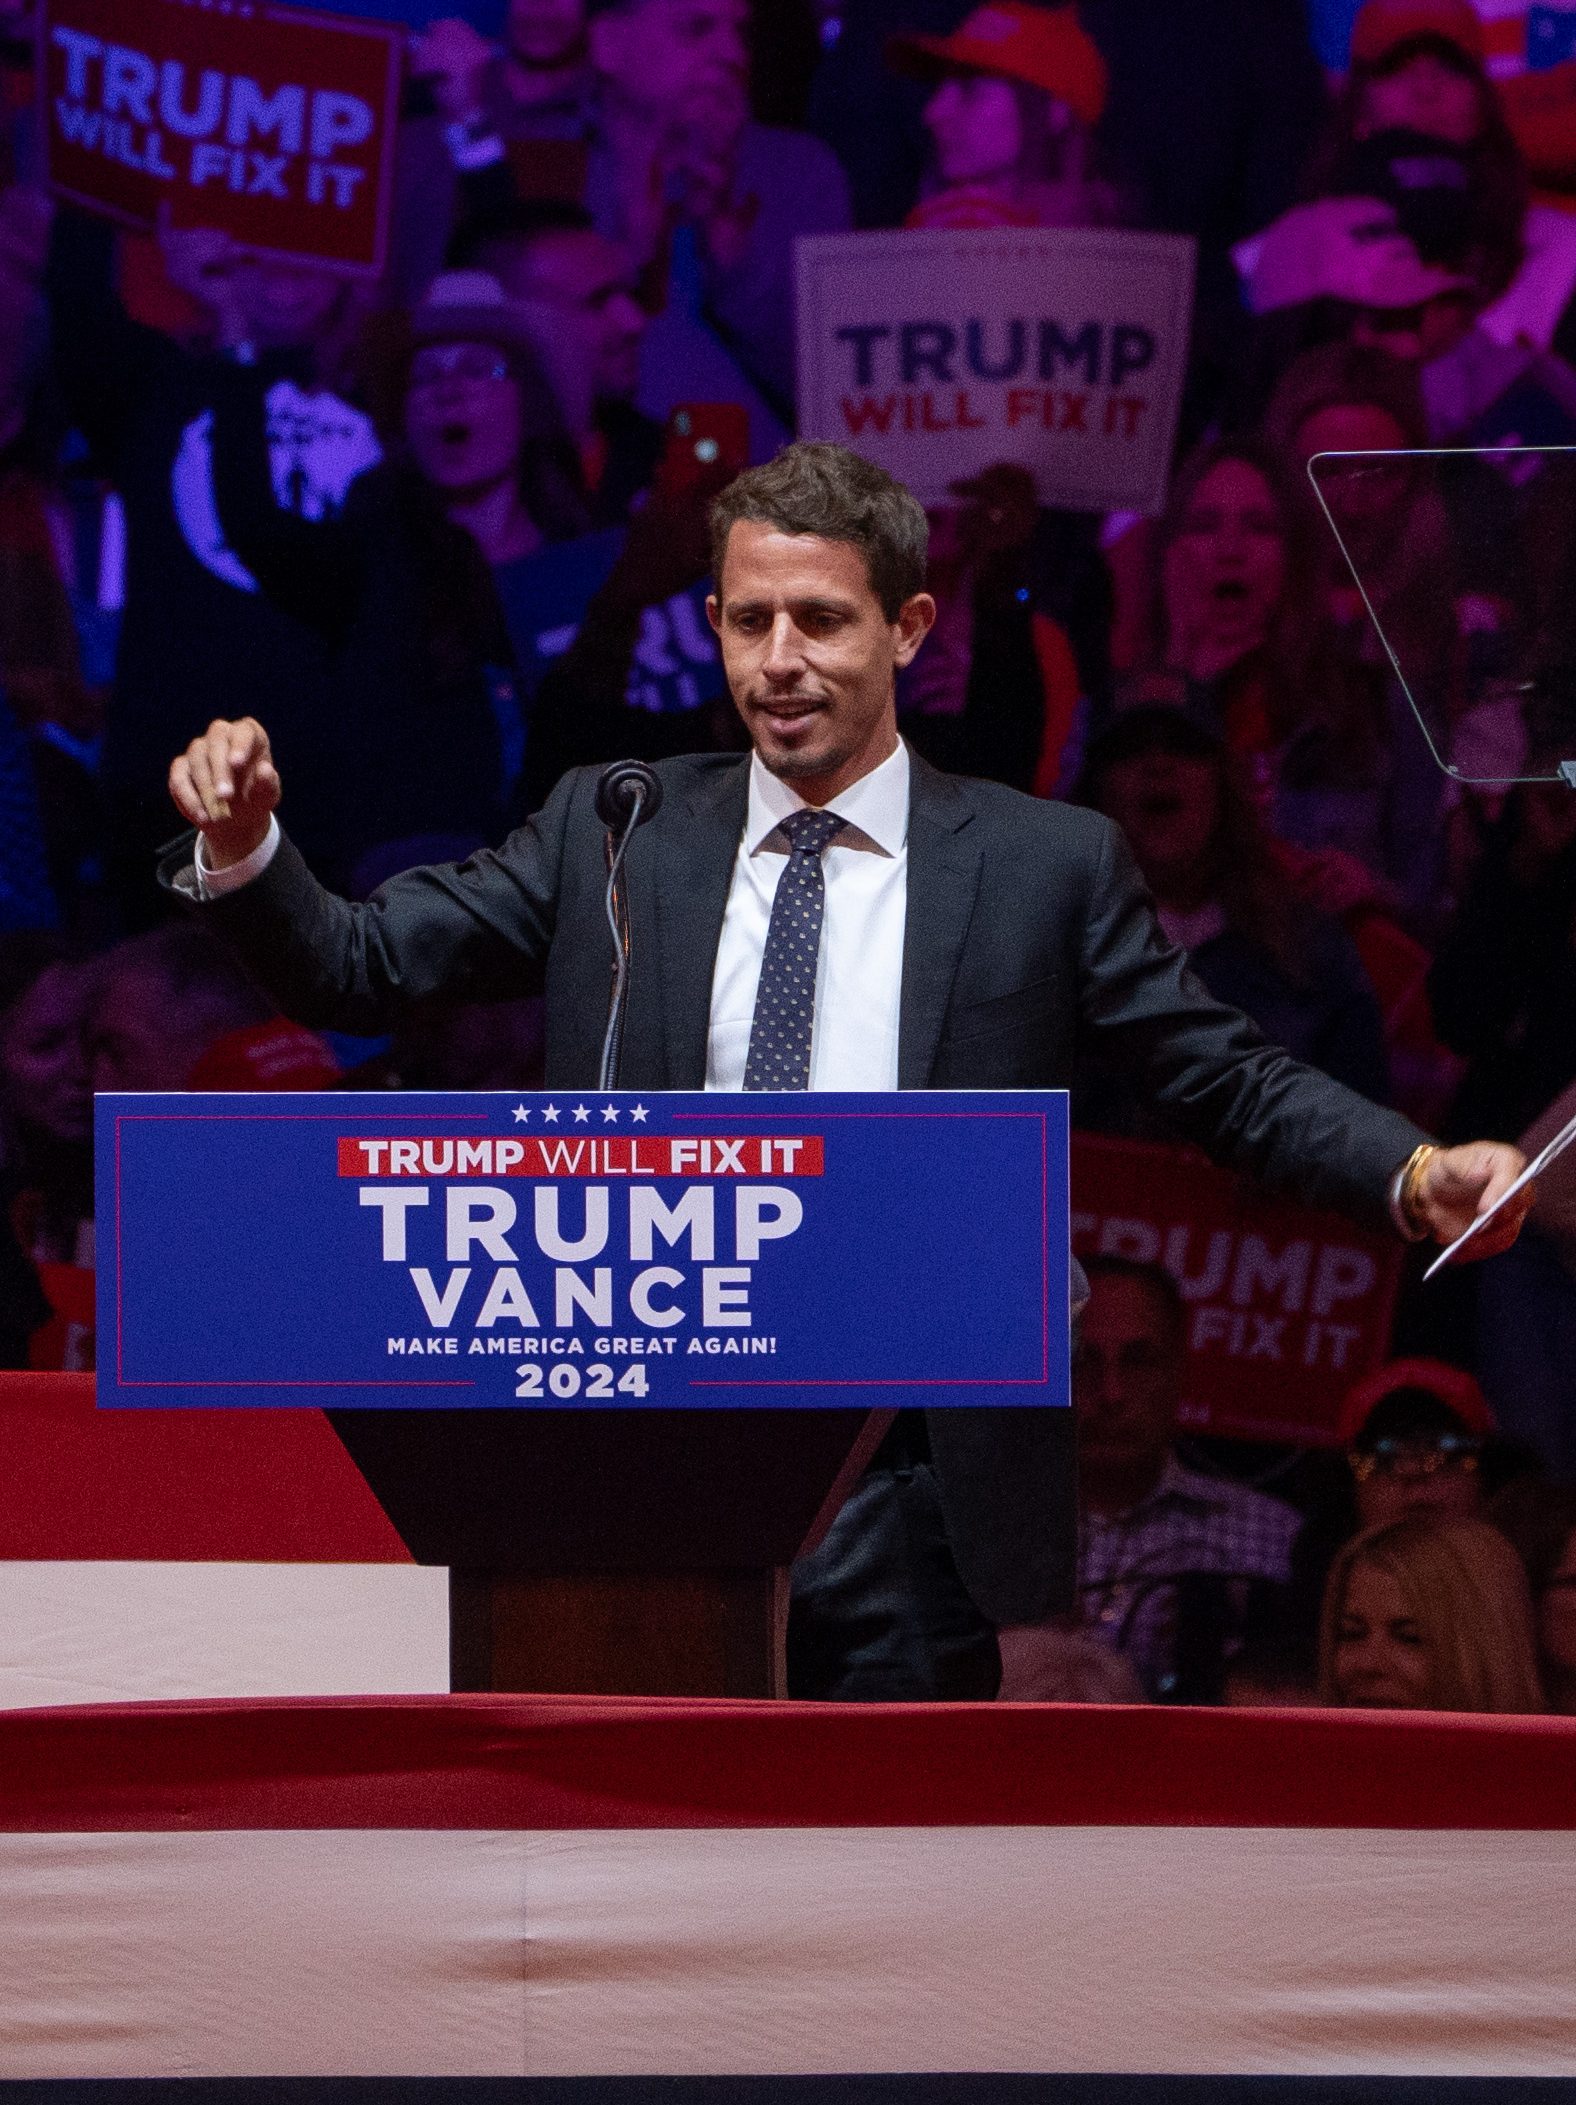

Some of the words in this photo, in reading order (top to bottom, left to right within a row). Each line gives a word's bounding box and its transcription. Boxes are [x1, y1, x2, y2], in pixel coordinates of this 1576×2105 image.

[51, 25, 375, 158] TRUMP
[54, 99, 178, 180] WILL
[190, 142, 290, 200] FIX
[306, 159, 367, 210] IT
[836, 318, 1157, 387] TRUMP
[841, 391, 986, 437] WILL
[1007, 389, 1088, 432] FIX
[1103, 398, 1146, 439] IT
[358, 1139, 525, 1174] TRUMP
[538, 1139, 655, 1174] WILL
[670, 1139, 747, 1173] FIX
[760, 1139, 803, 1173] IT
[359, 1185, 804, 1262] TRUMP
[408, 1266, 752, 1328] VANCE
[387, 1337, 458, 1355] MAKE
[467, 1337, 585, 1355] AMERICA
[594, 1337, 677, 1355] GREAT
[686, 1337, 777, 1355] AGAIN!
[1191, 1306, 1286, 1361] FIX
[1305, 1322, 1361, 1369] IT
[515, 1363, 650, 1398] 2024
